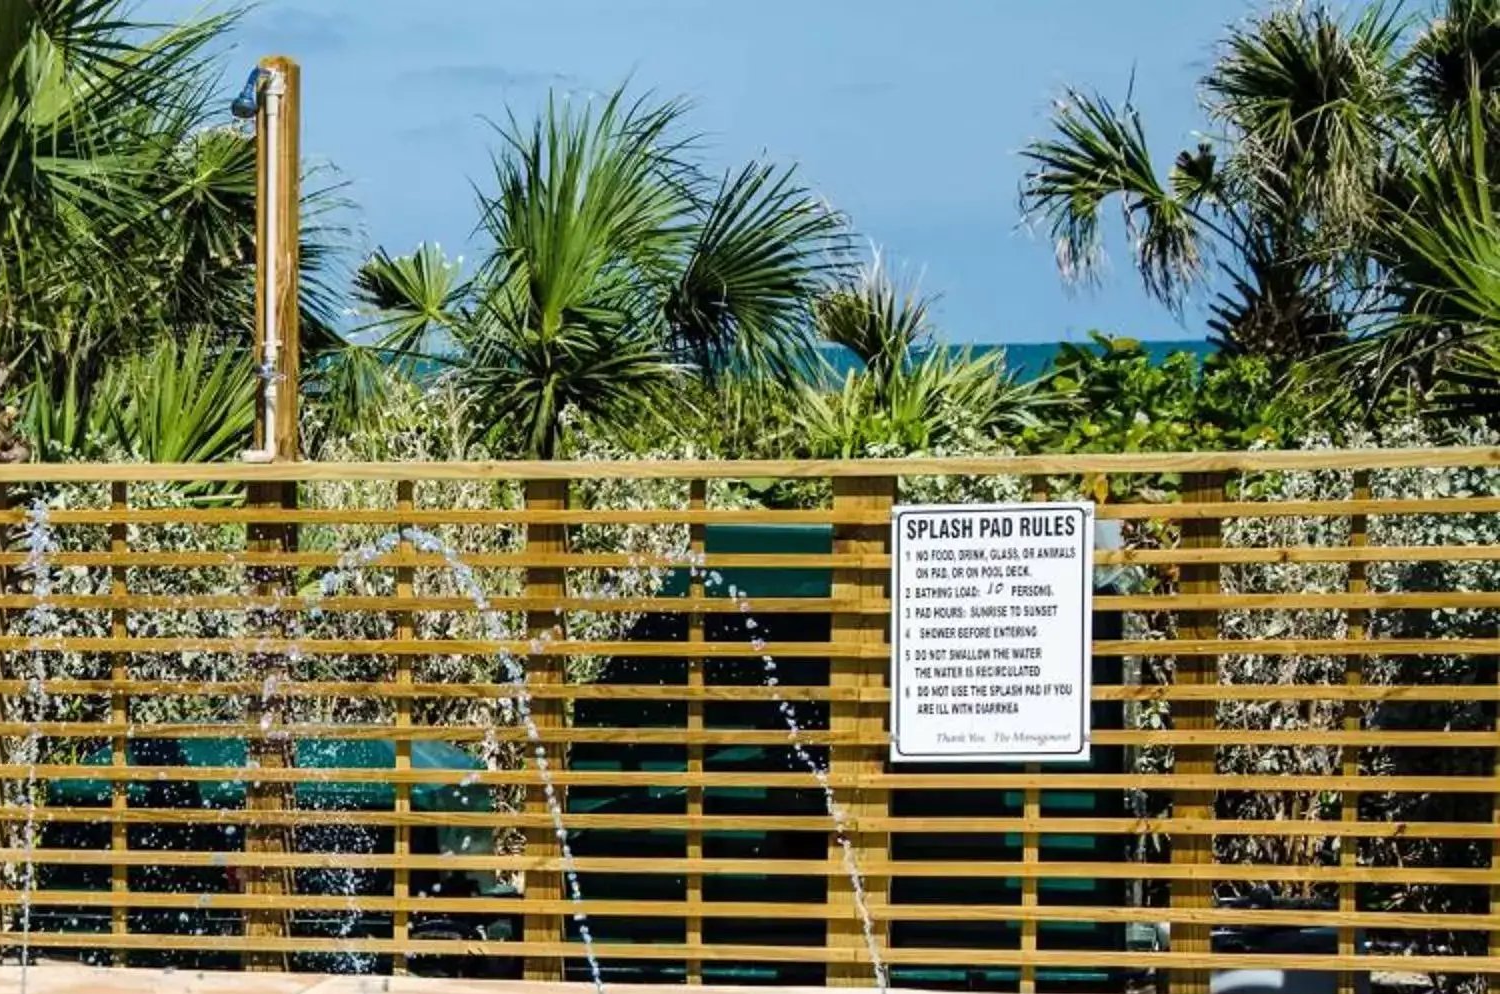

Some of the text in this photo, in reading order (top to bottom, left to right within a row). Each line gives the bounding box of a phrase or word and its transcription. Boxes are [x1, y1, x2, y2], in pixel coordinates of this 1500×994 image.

[907, 515, 1075, 540] SPLASH PAD RULES
[916, 550, 928, 561] NO
[932, 549, 956, 562] FOOD,
[959, 549, 988, 562] DRINK,
[1022, 547, 1035, 559] OR
[1037, 546, 1076, 558] ANIMALS
[916, 567, 928, 578] ON
[952, 567, 964, 578] OR
[966, 566, 979, 578] ON
[981, 566, 1003, 577] POOL
[916, 587, 952, 598] BATHING
[955, 586, 980, 598] LOAD:
[916, 607, 932, 618] PAD
[934, 607, 966, 618] HOURS:
[970, 606, 1007, 618] SUNRISE
[1010, 605, 1022, 617] TO
[1023, 605, 1058, 617] SUNSET
[920, 627, 956, 638] SHOWER
[958, 626, 991, 638] BEFORE
[994, 625, 1037, 637] ENTERING
[916, 649, 926, 660] DO
[929, 649, 946, 660] NOT
[949, 648, 990, 660] SWALLOW
[993, 647, 1009, 659] THE
[1012, 647, 1042, 659] WATER
[915, 665, 1041, 678] THE WATER IS RECIRCULATED
[917, 685, 929, 697] DO
[932, 685, 949, 697] NOT
[951, 685, 968, 697] USE
[971, 685, 987, 696] THE
[989, 684, 1023, 696] SPLASH
[1025, 684, 1042, 696] PAD
[1043, 684, 1052, 696] IF
[1054, 683, 1073, 695] YOU
[917, 702, 1019, 714] ARE ILL WITH DIARRHEA
[937, 733, 965, 743] Thank
[994, 731, 1011, 742] The
[1013, 731, 1071, 746] Management
